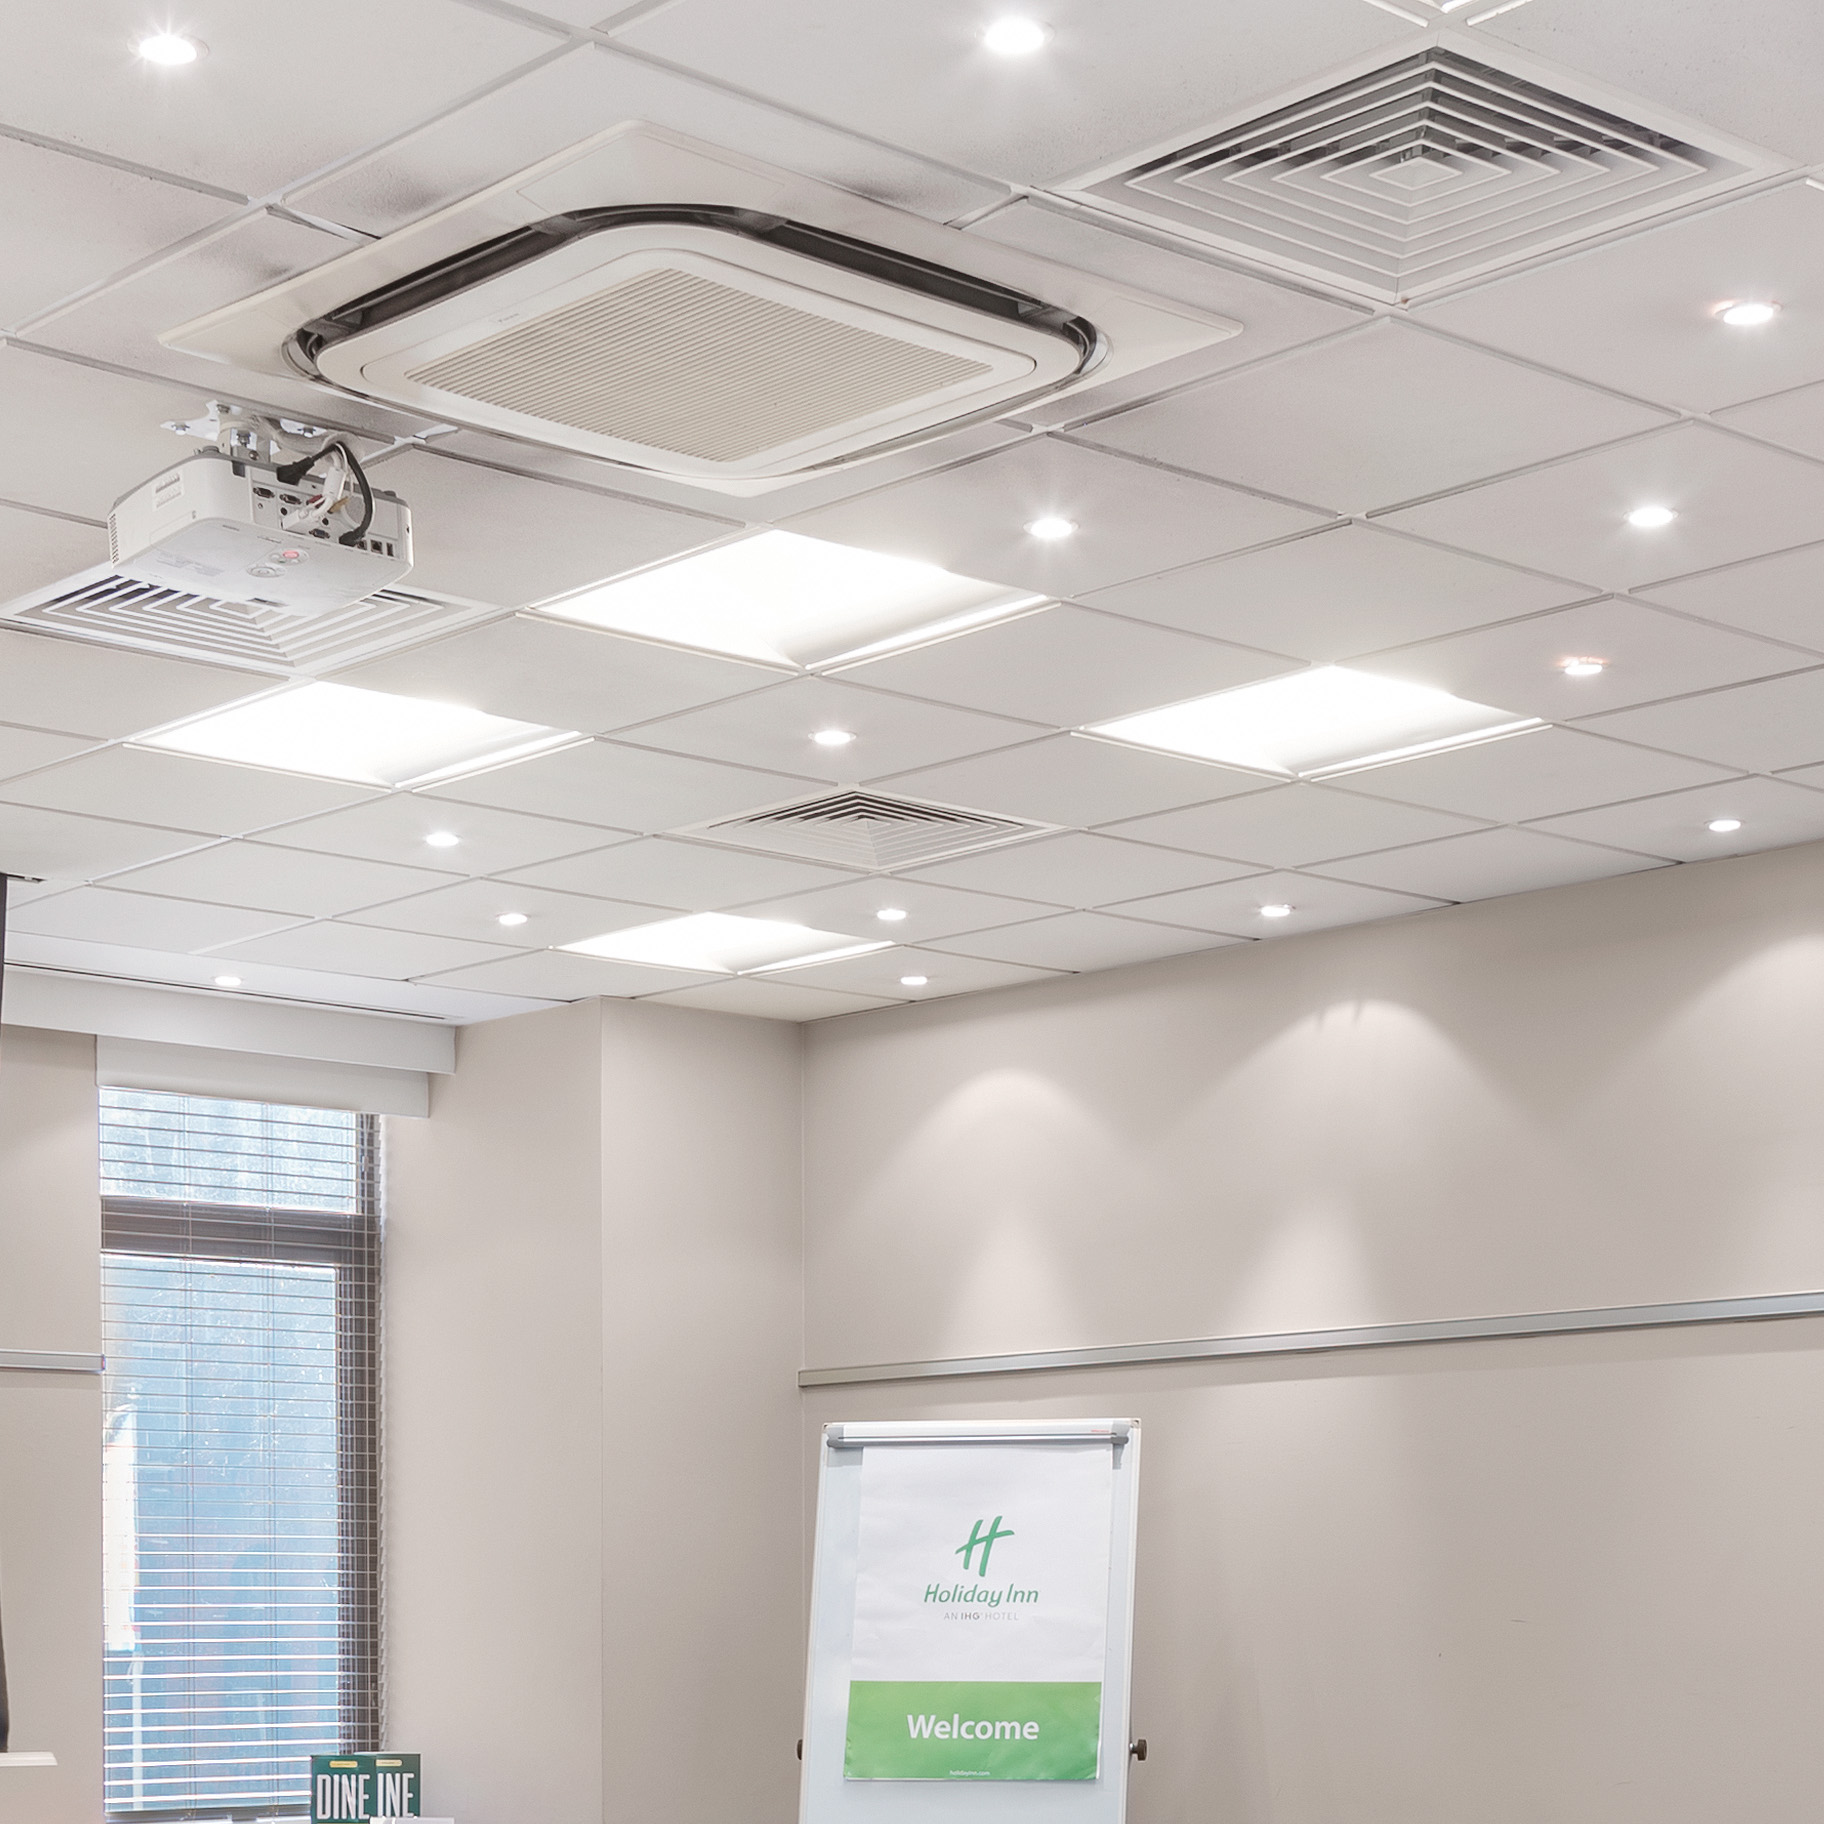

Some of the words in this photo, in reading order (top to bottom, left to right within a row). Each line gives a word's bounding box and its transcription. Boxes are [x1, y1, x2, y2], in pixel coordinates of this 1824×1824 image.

[924, 1583, 1003, 1608] Holiday
[1006, 1583, 1039, 1603] Inn
[943, 1612, 958, 1620] AN
[984, 1612, 1019, 1620] HOTEL
[907, 1714, 1040, 1741] Welcome
[316, 1774, 370, 1820] DINE
[377, 1773, 415, 1817] INE
